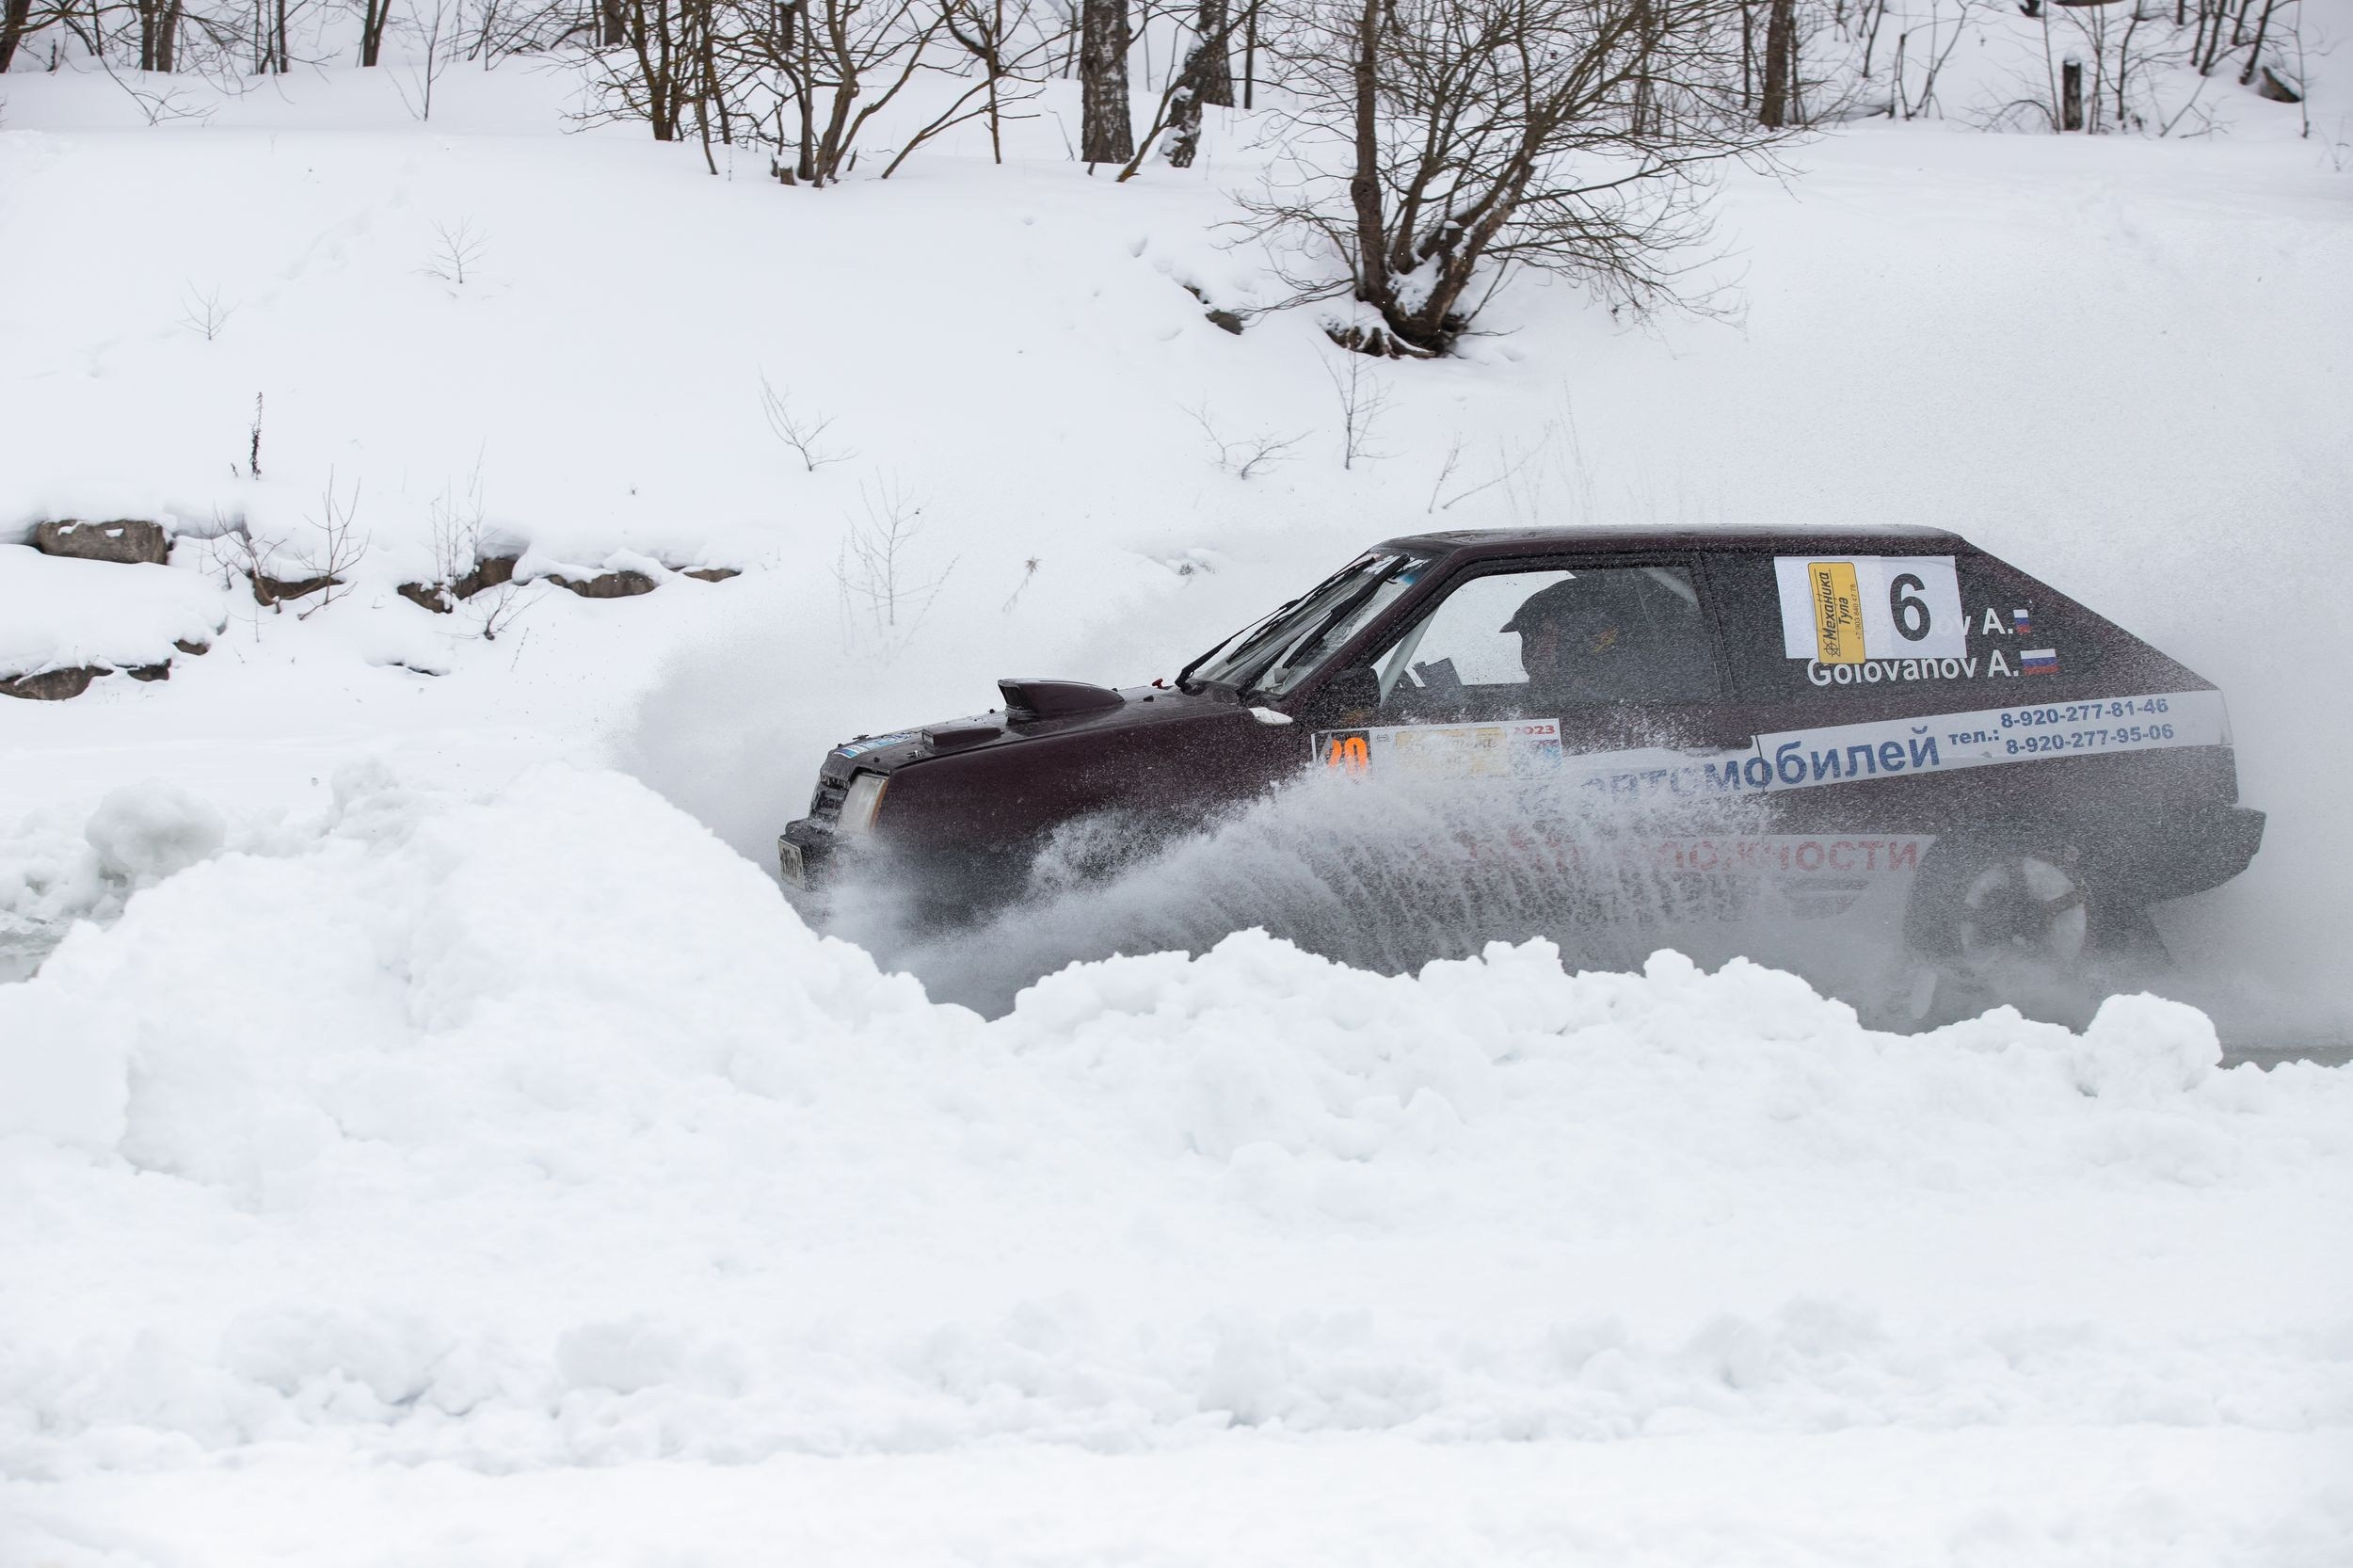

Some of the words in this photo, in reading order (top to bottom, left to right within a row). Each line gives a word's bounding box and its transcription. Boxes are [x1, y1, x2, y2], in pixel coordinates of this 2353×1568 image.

[1818, 571, 1837, 641] Механика
[1838, 597, 1852, 625] Тула
[1890, 573, 1931, 642] 6
[1982, 607, 2013, 635] A.
[1807, 658, 1977, 686] Golovanov
[1988, 649, 2019, 678] A.
[2000, 698, 2169, 728] 8-920-277-81-46
[1948, 728, 2000, 745] тел.:
[2006, 724, 2174, 754] 8-920-277-95-06
